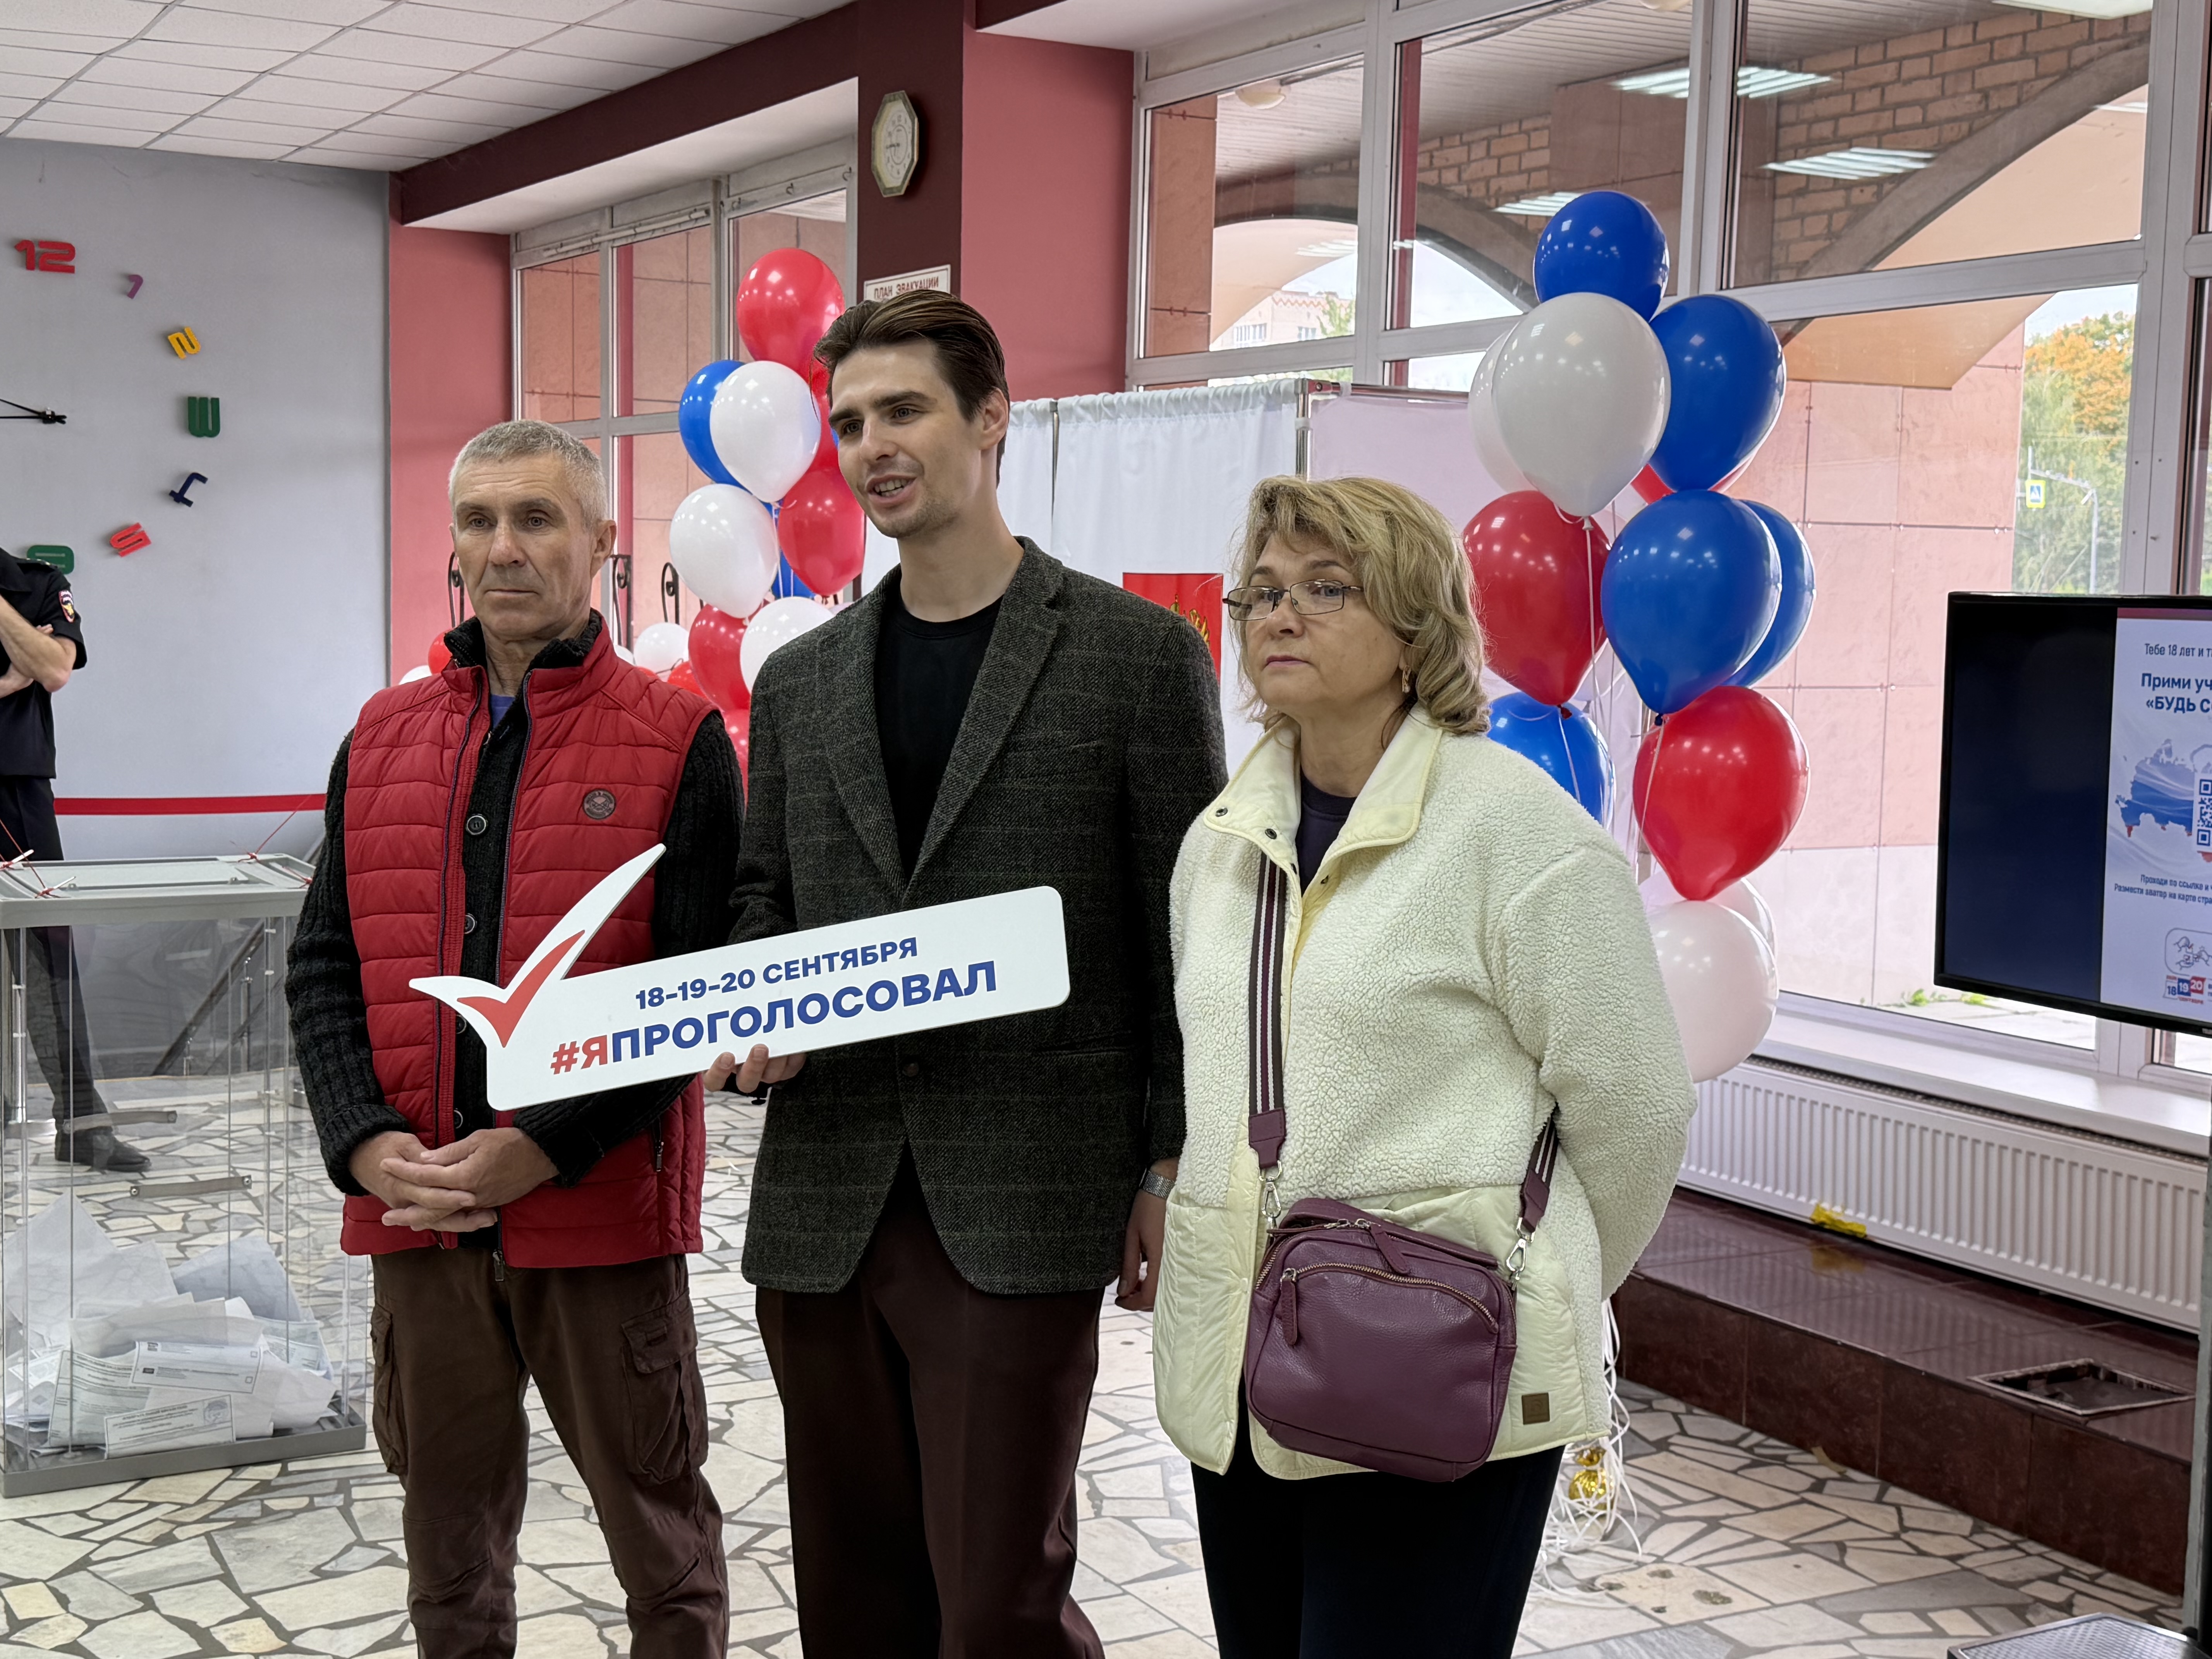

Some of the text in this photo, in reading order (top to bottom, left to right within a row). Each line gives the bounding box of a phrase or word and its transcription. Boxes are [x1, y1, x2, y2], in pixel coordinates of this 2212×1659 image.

[14, 240, 76, 274] 12
[128, 274, 144, 299] 1
[874, 276, 939, 299] ПЛАН ЭВАКУАЦИИ
[167, 326, 201, 359] 2
[188, 397, 220, 438] 3
[169, 472, 208, 507] 4
[109, 522, 151, 558] 5
[2145, 643, 2165, 655] Тебе
[2168, 644, 2177, 656] 18
[2179, 647, 2195, 657] лет
[2198, 648, 2203, 657] и
[2141, 673, 2191, 691] Прими
[2146, 696, 2212, 714] «БУДЬ С
[2114, 883, 2143, 894] Размести
[2141, 874, 2167, 885] Проходи
[636, 938, 917, 1009] 18-19-20 СЕНТЯБРЯ
[2190, 979, 2203, 991] 20
[2167, 986, 2176, 995] 18
[2179, 982, 2188, 992] 19
[551, 961, 996, 1073] #ЯПРОГОЛОСОВАЛ
